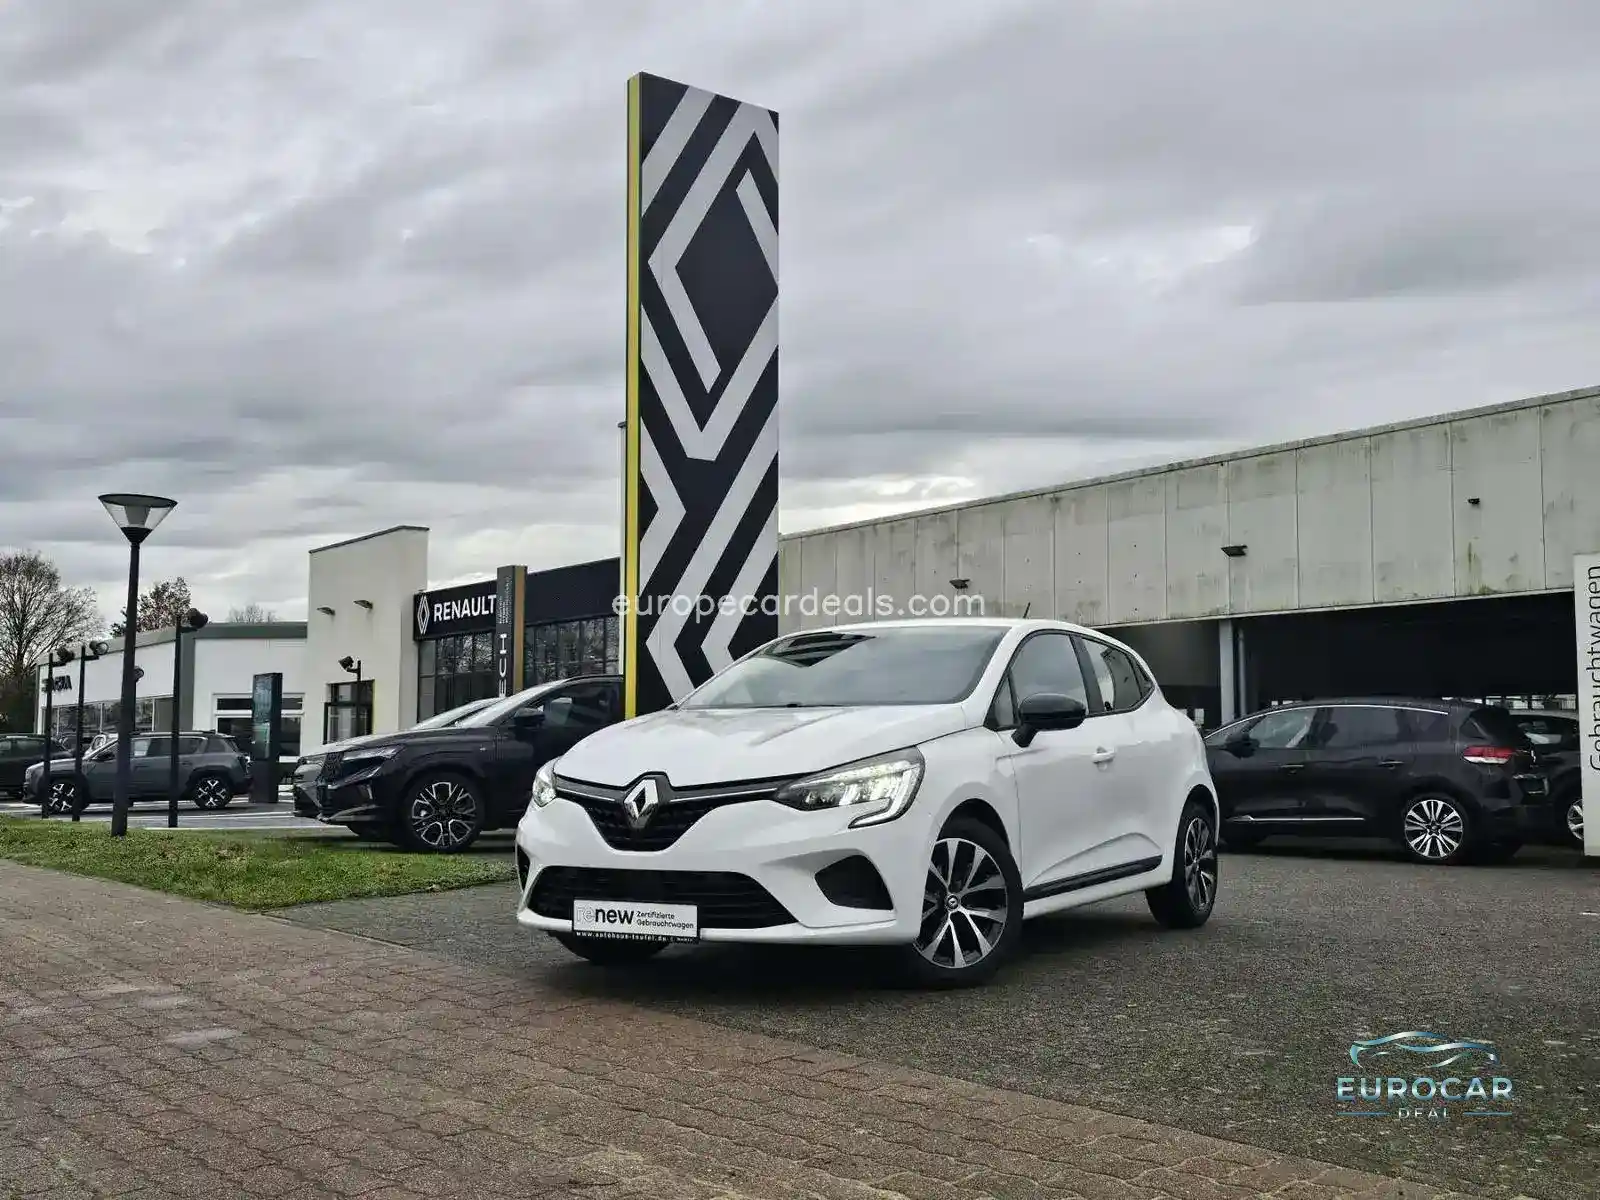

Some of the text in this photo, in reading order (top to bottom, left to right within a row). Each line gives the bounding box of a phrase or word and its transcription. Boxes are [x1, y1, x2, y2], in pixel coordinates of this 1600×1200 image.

[433, 595, 497, 622] RENAULT
[636, 911, 675, 920] Zertifizierte
[637, 919, 694, 930] Gebrauchtwagen
